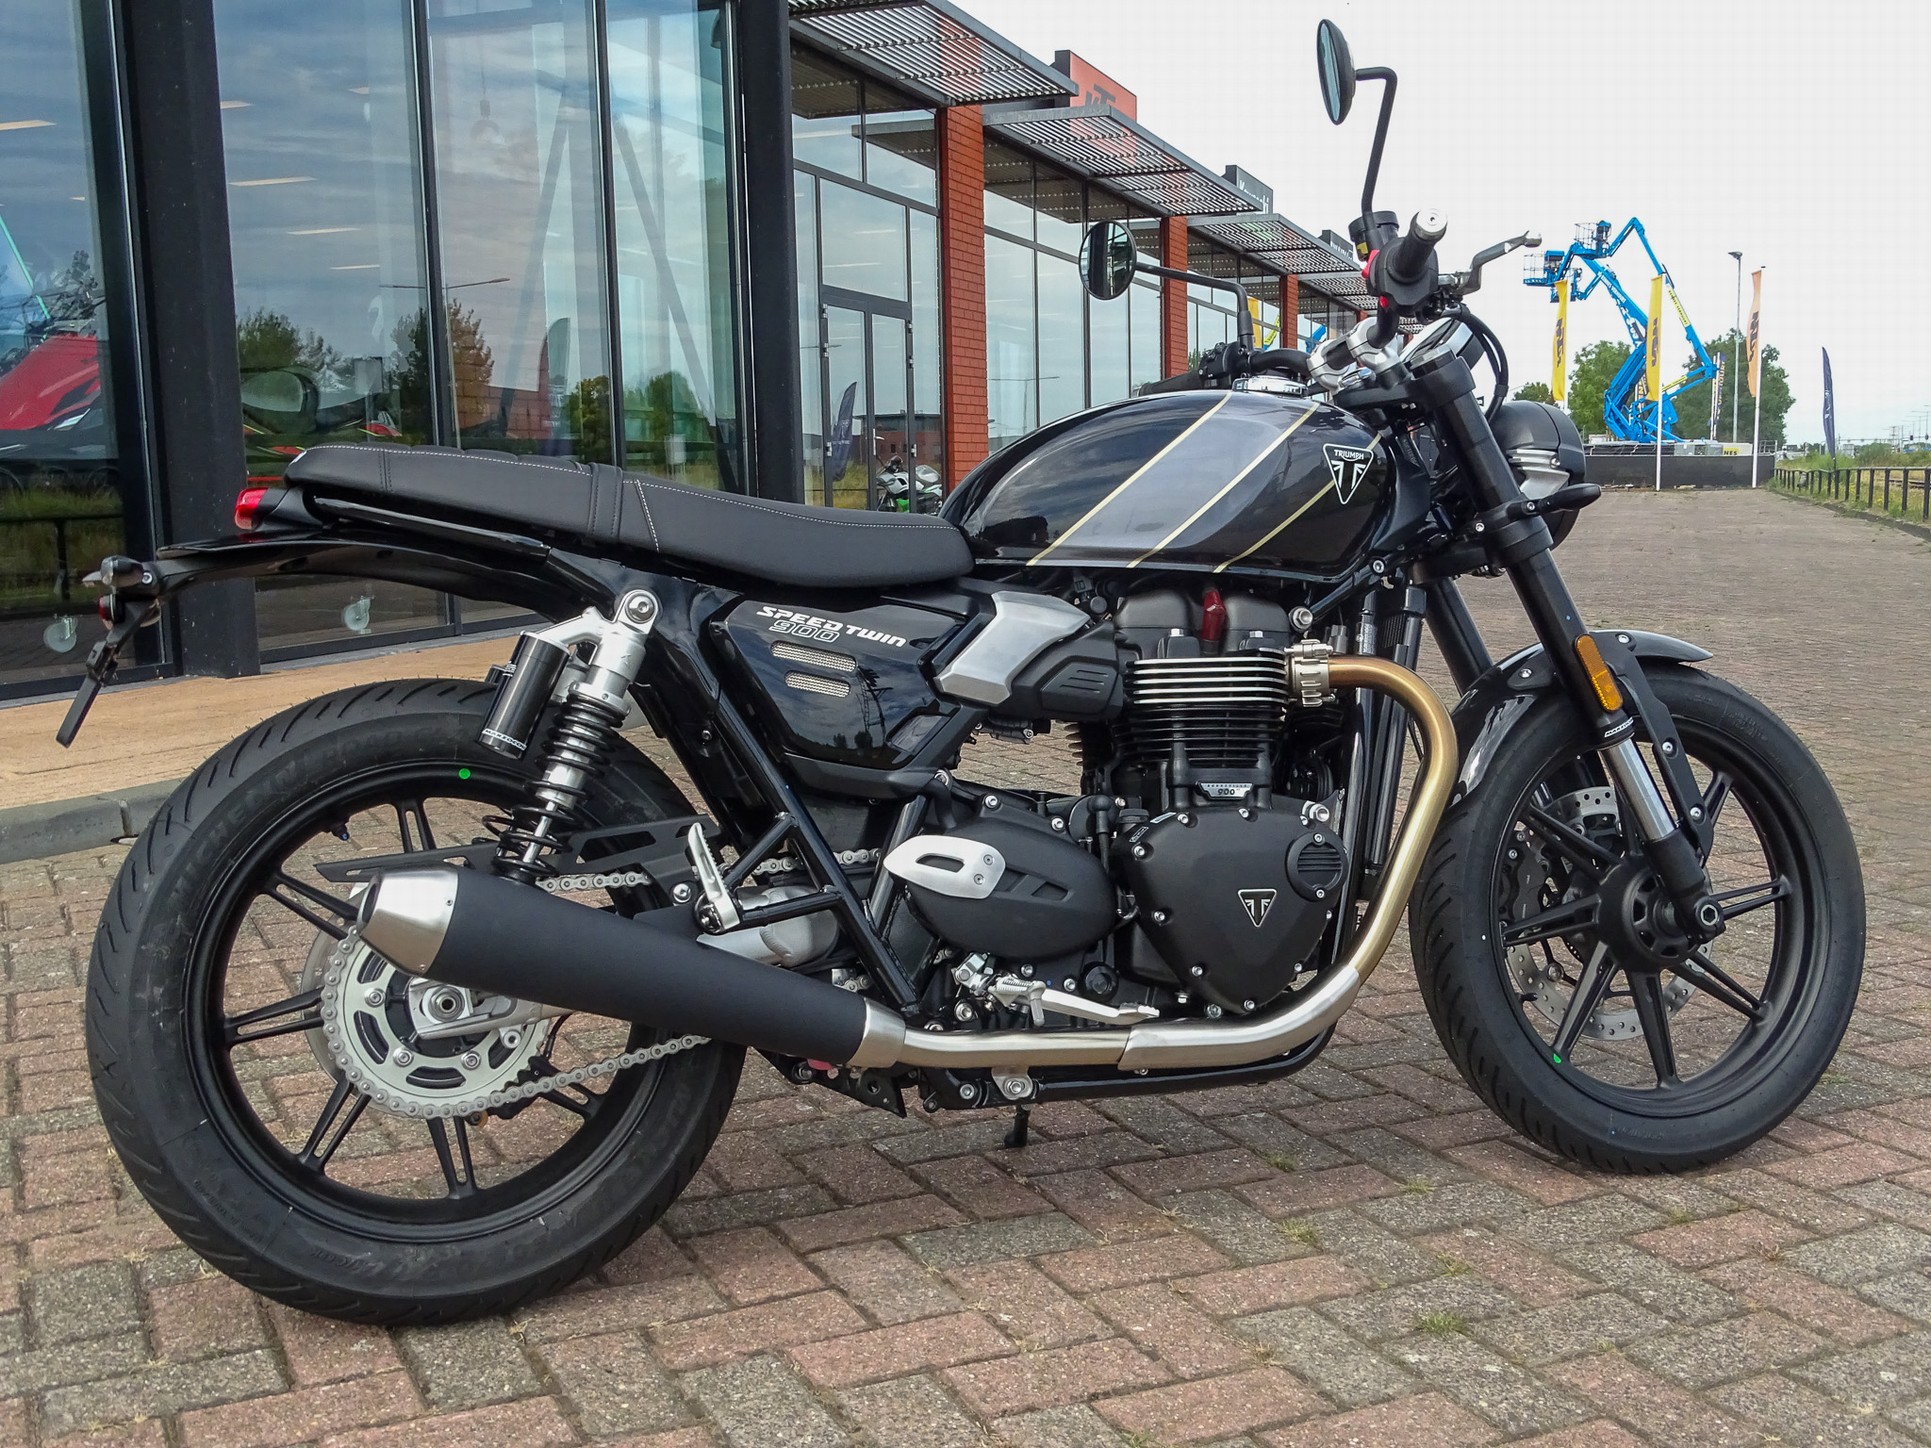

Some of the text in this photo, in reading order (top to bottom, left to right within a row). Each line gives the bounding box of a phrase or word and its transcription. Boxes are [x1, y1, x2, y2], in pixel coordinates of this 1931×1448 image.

[1334, 449, 1365, 461] TRIUMPH
[757, 606, 907, 648] SPEED TWIN
[768, 619, 840, 643] 900
